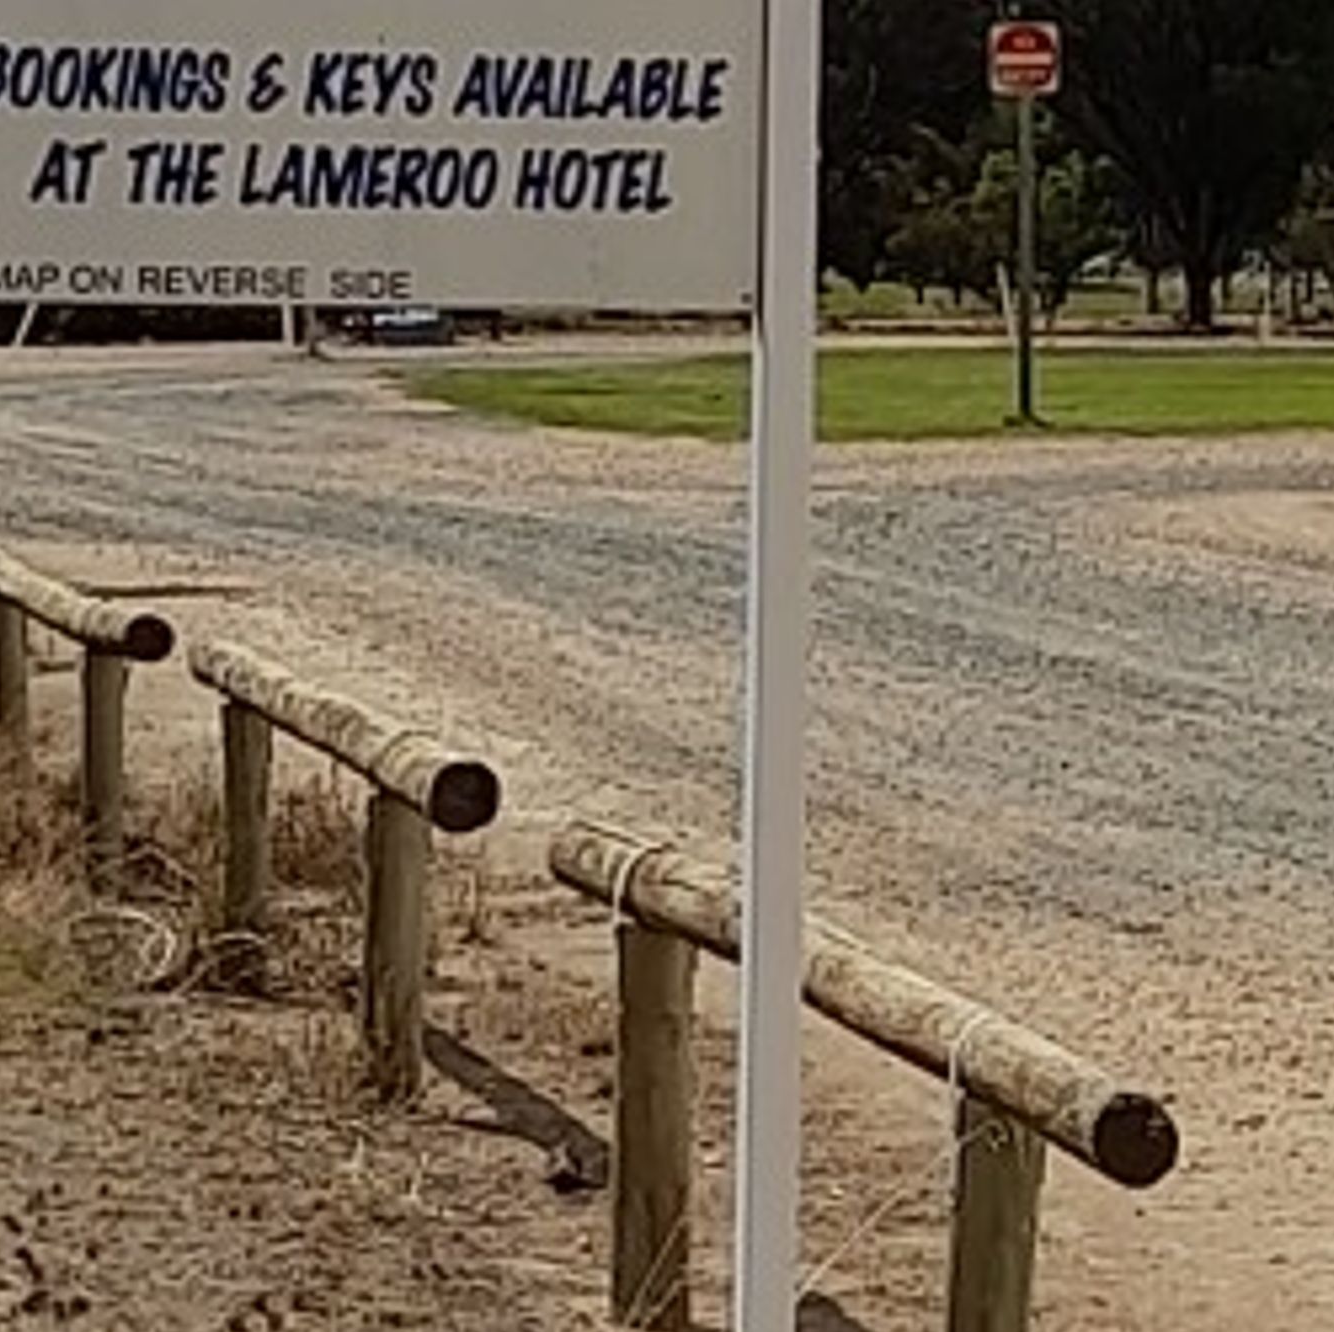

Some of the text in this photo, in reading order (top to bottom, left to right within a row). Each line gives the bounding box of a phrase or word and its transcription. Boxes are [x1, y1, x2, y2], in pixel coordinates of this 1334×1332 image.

[248, 54, 287, 112] &
[305, 54, 437, 116] KEYS
[453, 56, 729, 119] AVAILABLE
[29, 141, 674, 212] AT THE LAMEROO HOTEL
[68, 266, 124, 295] ON
[137, 267, 307, 298] REVERSE
[329, 270, 413, 298] SIDE
